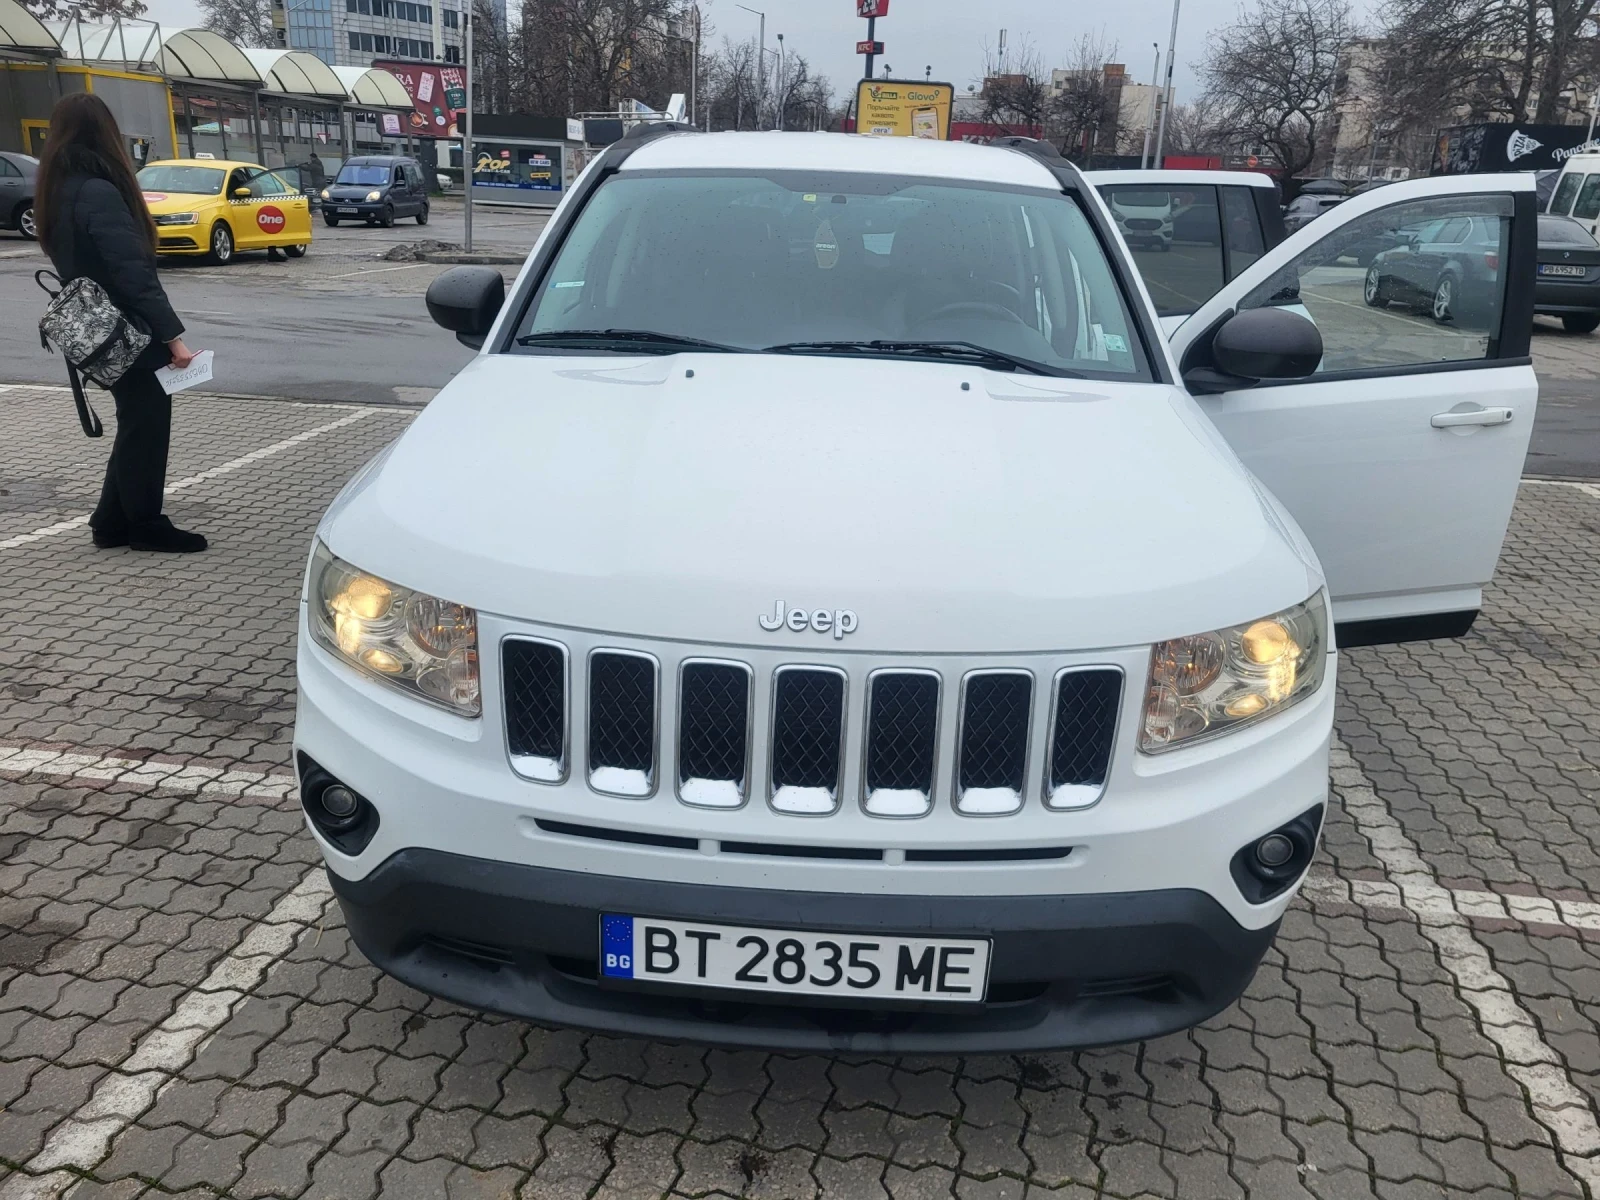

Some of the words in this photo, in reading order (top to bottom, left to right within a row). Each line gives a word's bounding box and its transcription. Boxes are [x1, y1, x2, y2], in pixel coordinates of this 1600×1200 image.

[857, 43, 870, 51] KFC
[907, 92, 935, 101] Glovo
[866, 103, 900, 112] Поръчайте
[1512, 136, 1527, 157] PIZZA
[474, 158, 510, 173] TOP
[258, 213, 284, 224] One
[1555, 266, 1573, 275] 6952
[759, 599, 859, 641] Jeep
[606, 953, 631, 969] BG
[644, 926, 721, 979] BT
[735, 935, 881, 990] 2835
[894, 945, 976, 993] ME
